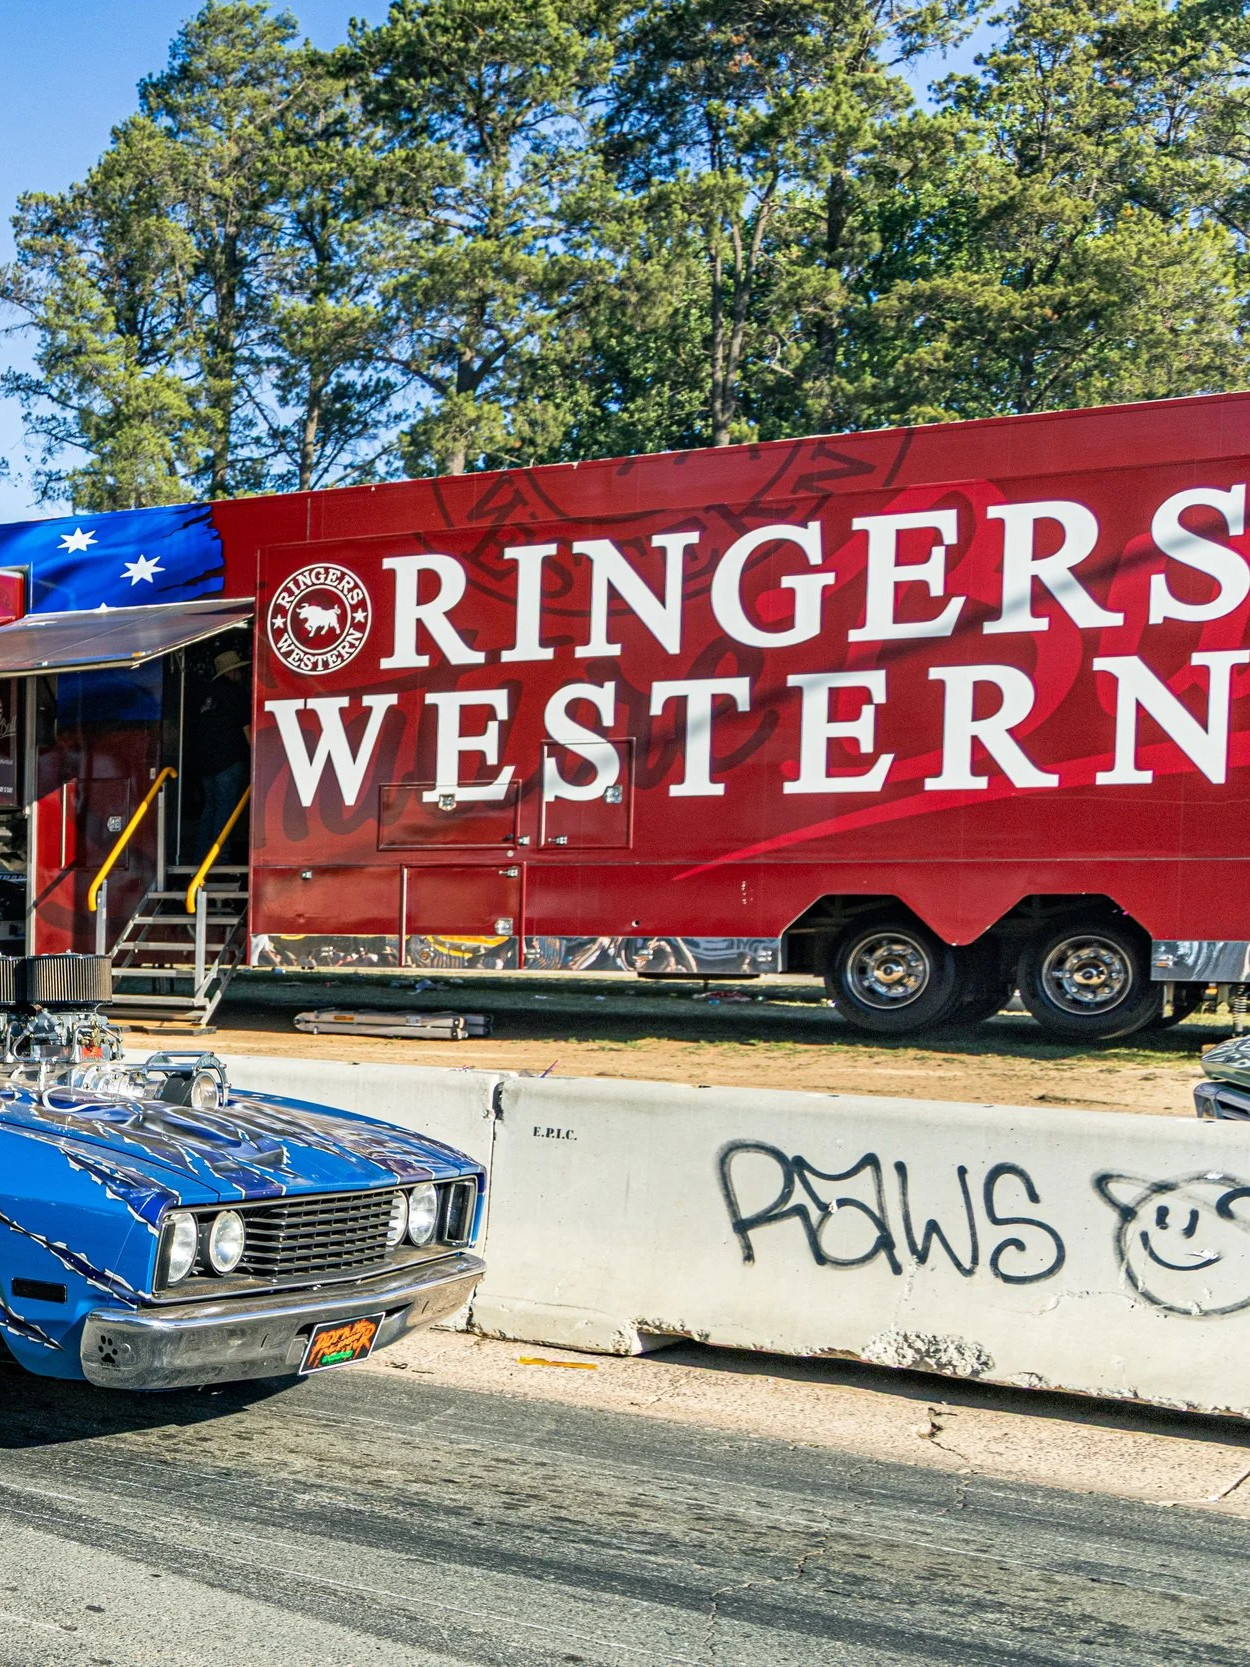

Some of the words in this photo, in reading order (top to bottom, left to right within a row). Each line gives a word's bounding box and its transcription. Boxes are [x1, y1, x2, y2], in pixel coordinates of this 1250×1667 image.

[277, 567, 364, 610] RINGERS
[379, 484, 1250, 670] RINGERS
[277, 627, 364, 671] WESTERN
[264, 648, 1250, 807] WESTERN
[533, 1126, 578, 1141] E.P.I.C.
